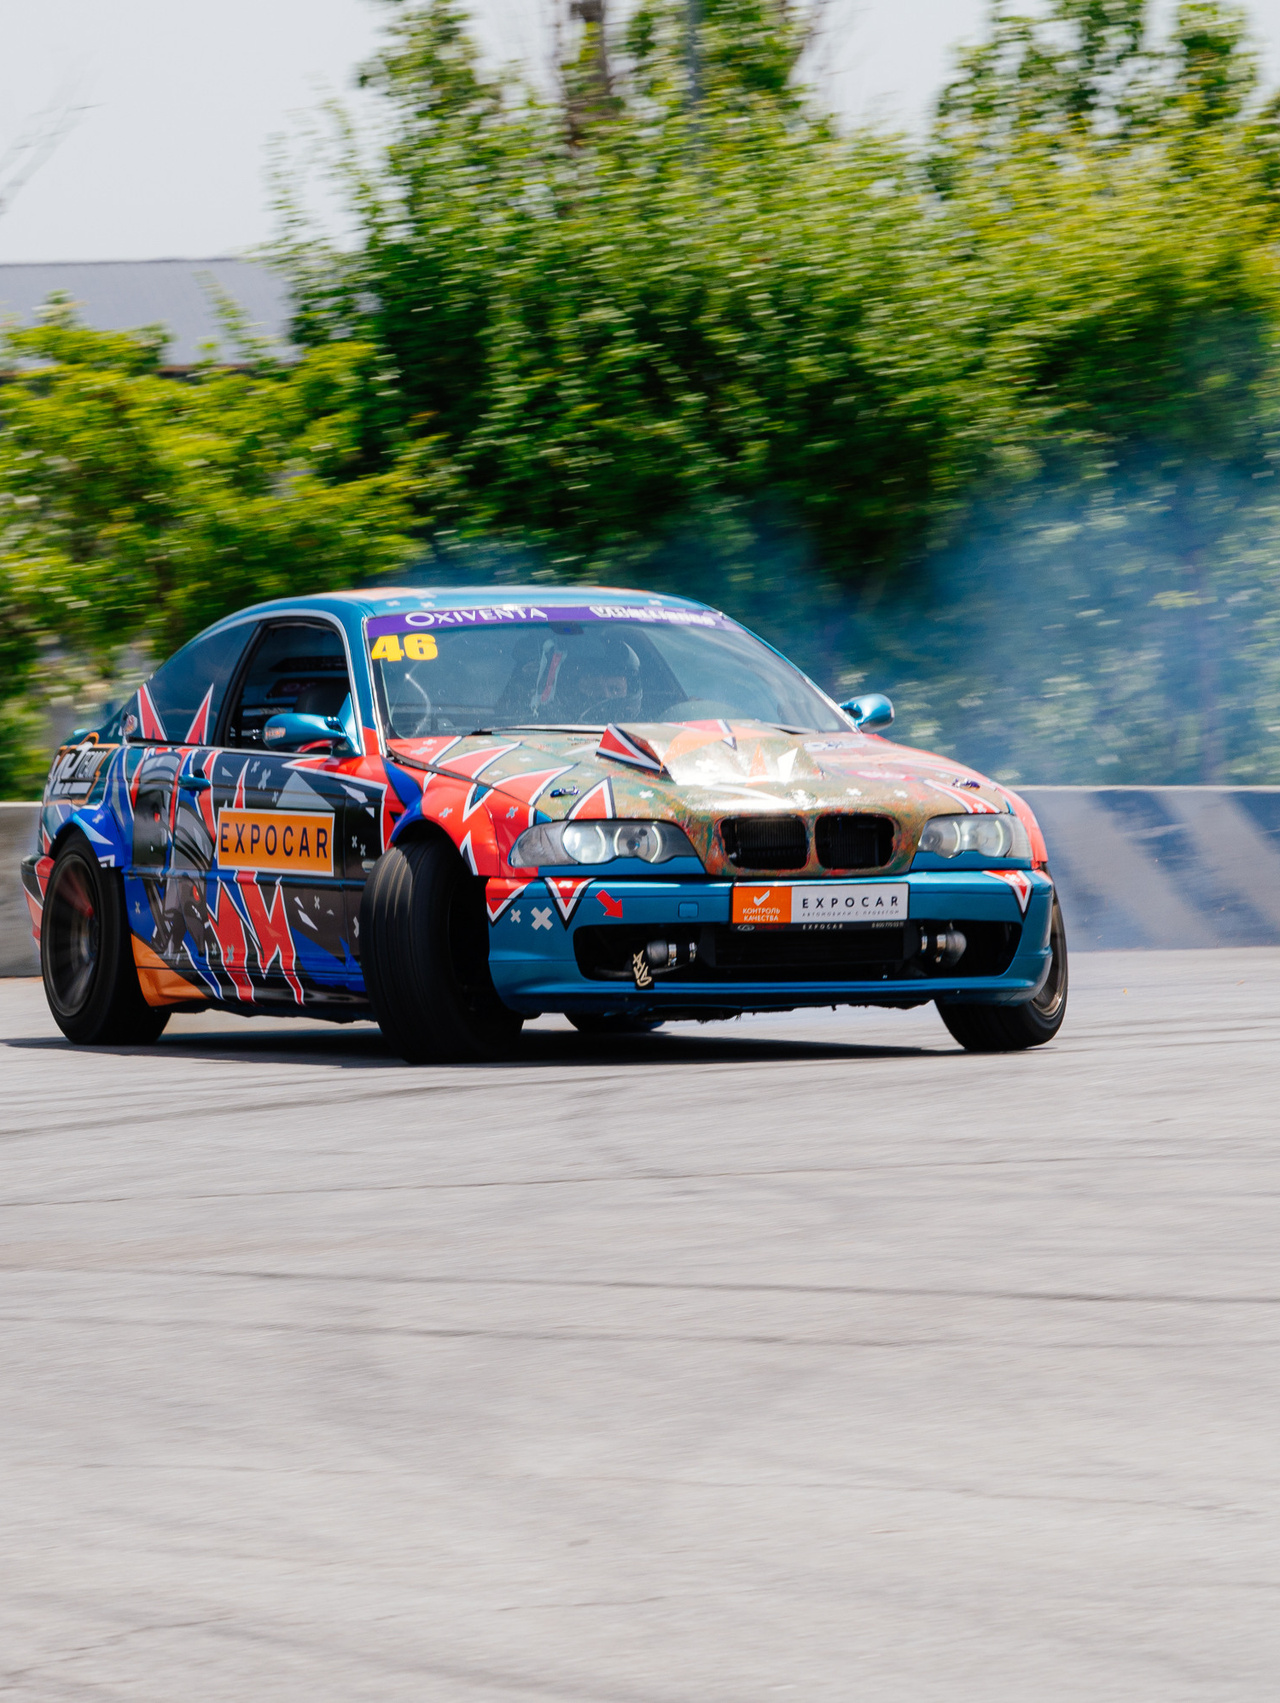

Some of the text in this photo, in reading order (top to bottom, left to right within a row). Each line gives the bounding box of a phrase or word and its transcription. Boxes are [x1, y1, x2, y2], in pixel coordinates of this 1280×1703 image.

[371, 633, 438, 662] 46
[220, 823, 328, 859] EXPOCAR
[742, 907, 781, 915] КОНТРОЛЬ
[802, 896, 899, 909] EXPOCAR
